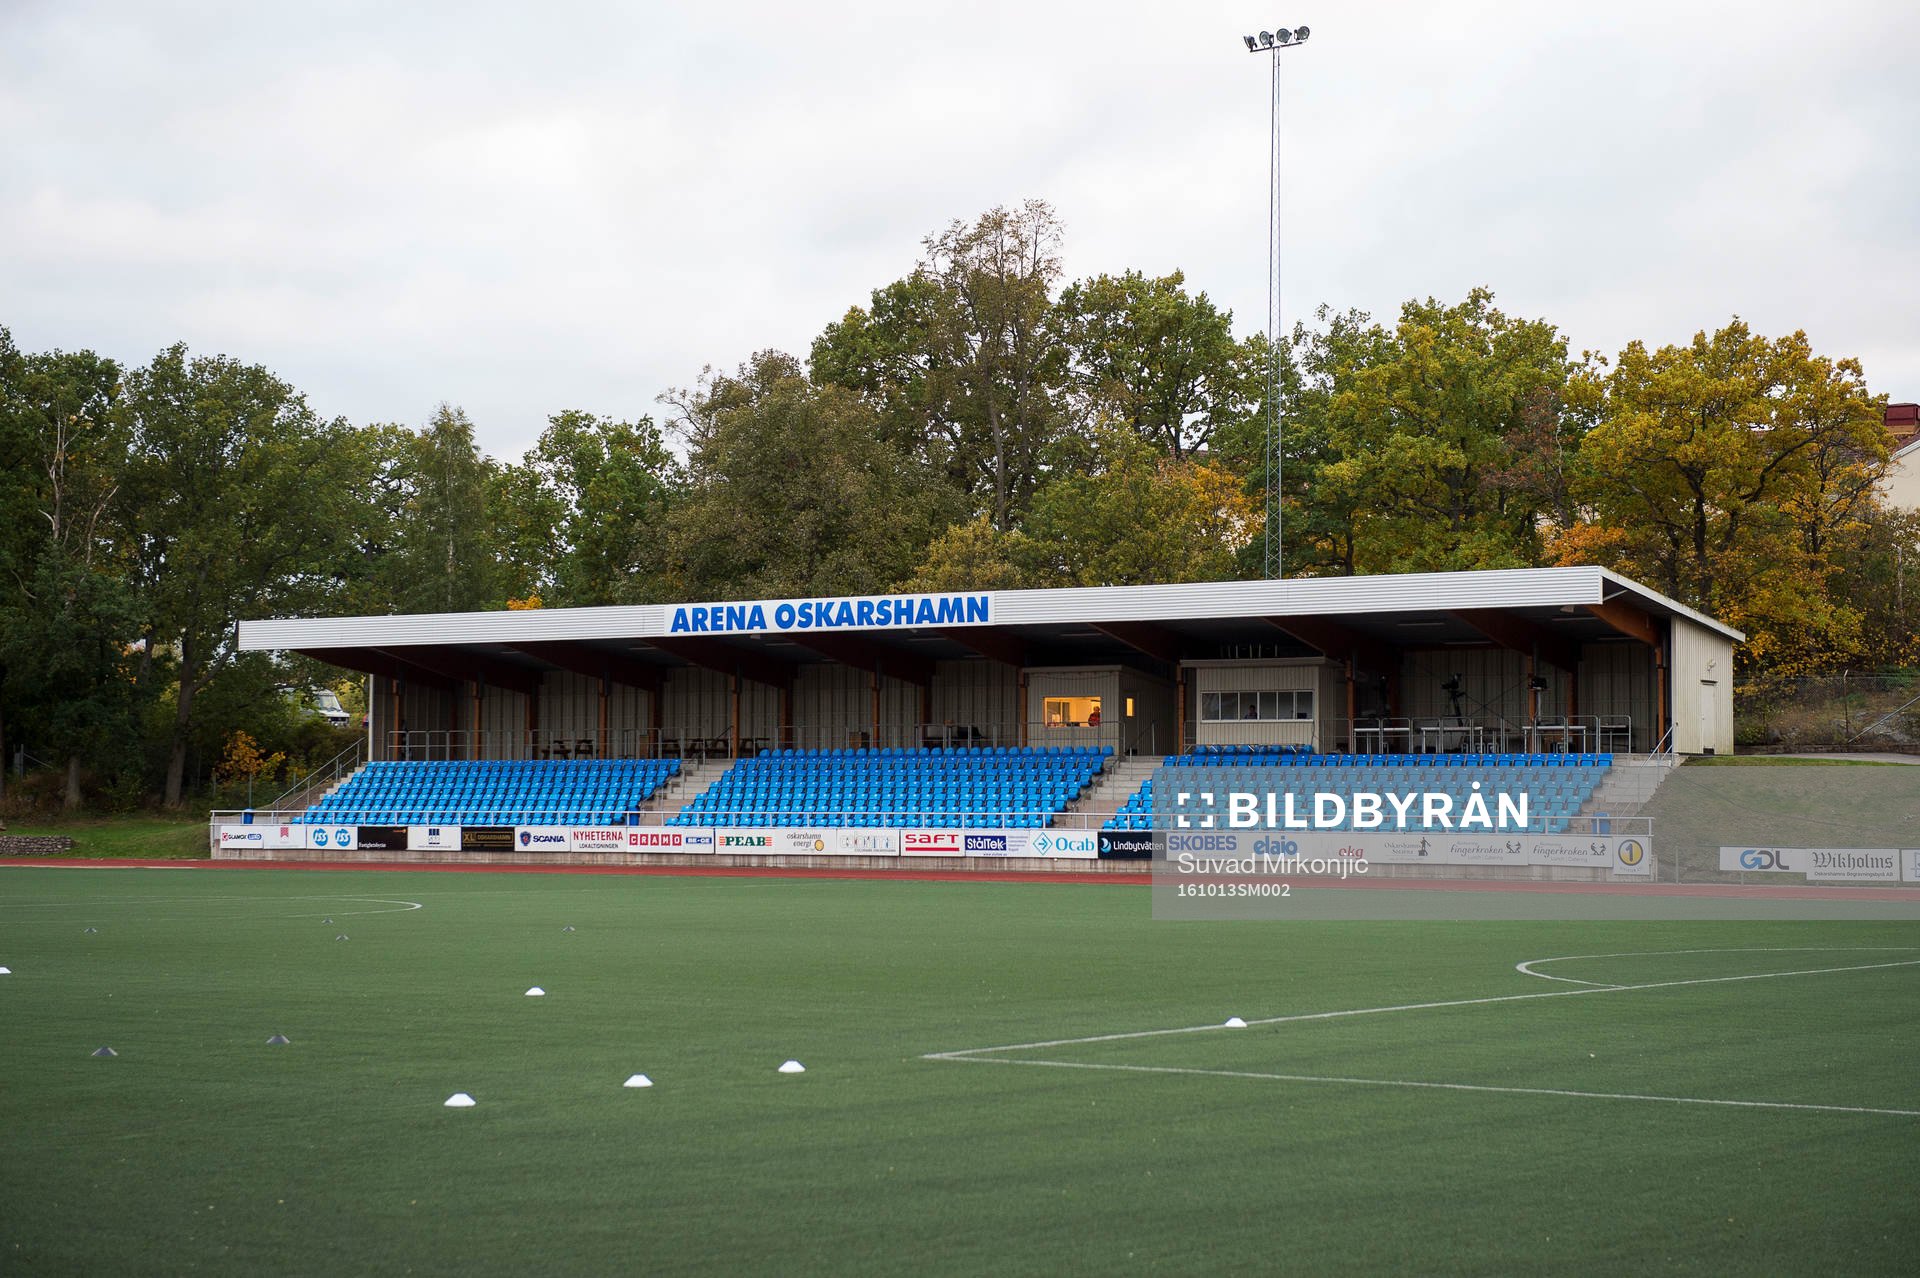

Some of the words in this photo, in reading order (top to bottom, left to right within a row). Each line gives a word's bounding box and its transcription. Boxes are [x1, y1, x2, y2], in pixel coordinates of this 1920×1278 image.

[670, 605, 767, 632] ARENA
[774, 596, 989, 629] OSKARSHAMN
[573, 831, 623, 841] NYHETERNA
[630, 834, 682, 846] CRAMO
[726, 837, 766, 846] PEAB
[1168, 835, 1237, 850] SKOBES
[967, 838, 1005, 850] StålTek
[1056, 837, 1095, 851] Ocab
[1812, 852, 1894, 869] Wikholms
